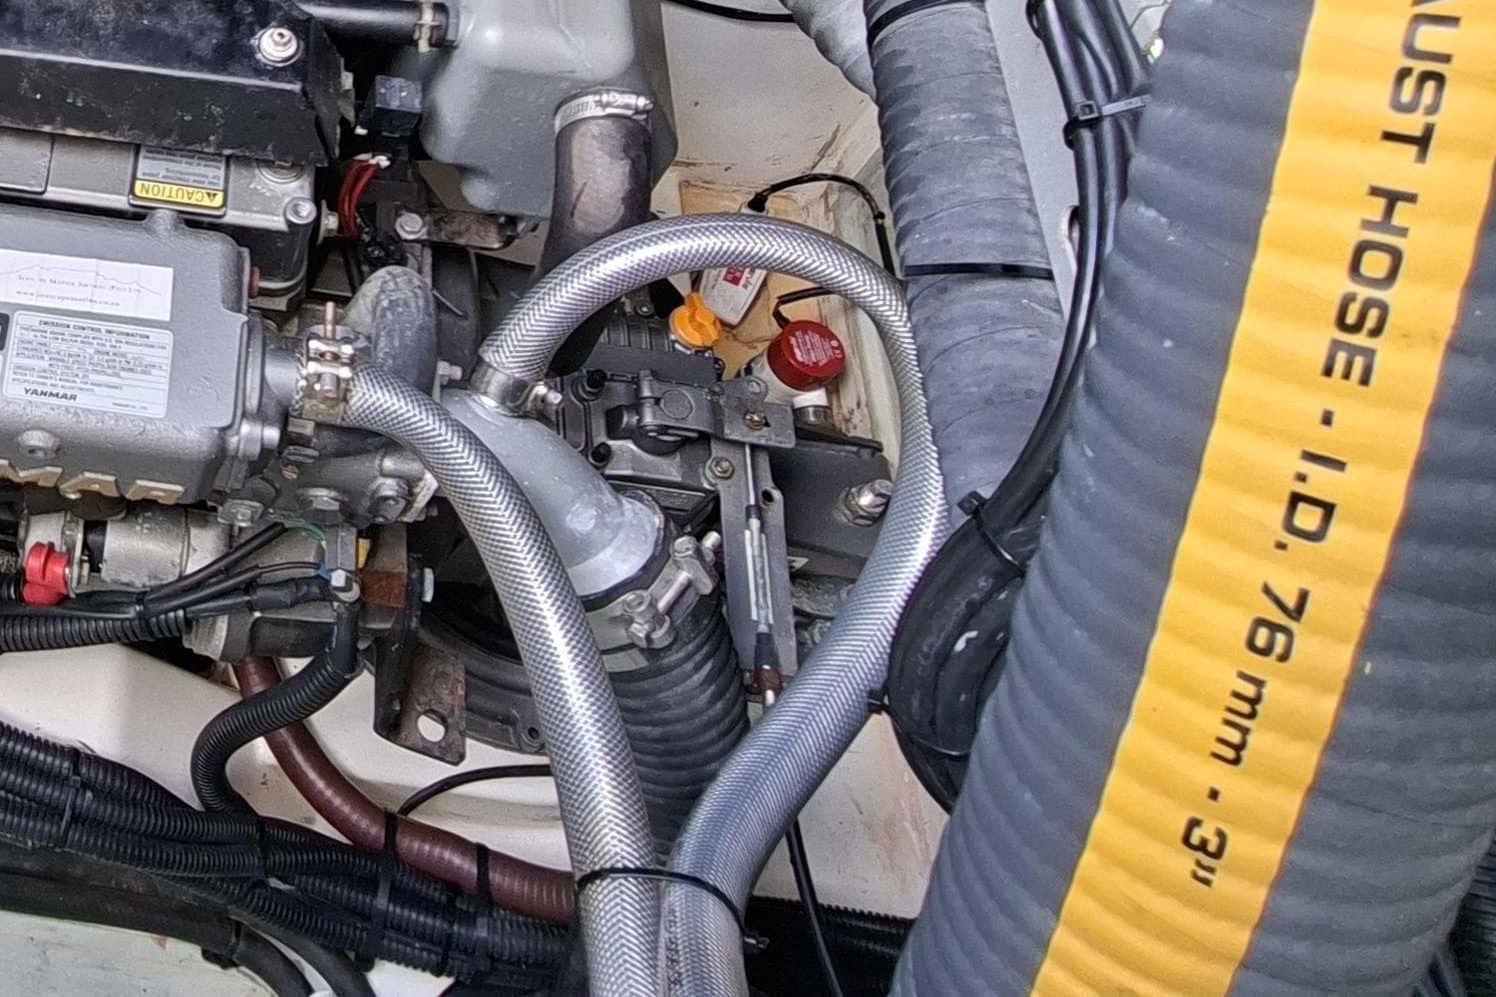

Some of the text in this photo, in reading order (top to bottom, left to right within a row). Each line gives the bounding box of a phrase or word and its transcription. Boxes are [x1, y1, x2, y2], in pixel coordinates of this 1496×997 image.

[140, 183, 205, 203] CAUTION
[1320, 183, 1418, 389] HOSE
[73, 324, 103, 334] CONTROL
[24, 387, 78, 401] YANMAR
[1275, 449, 1347, 553] I.D.
[1246, 582, 1310, 663] 76
[1209, 669, 1266, 767] mm
